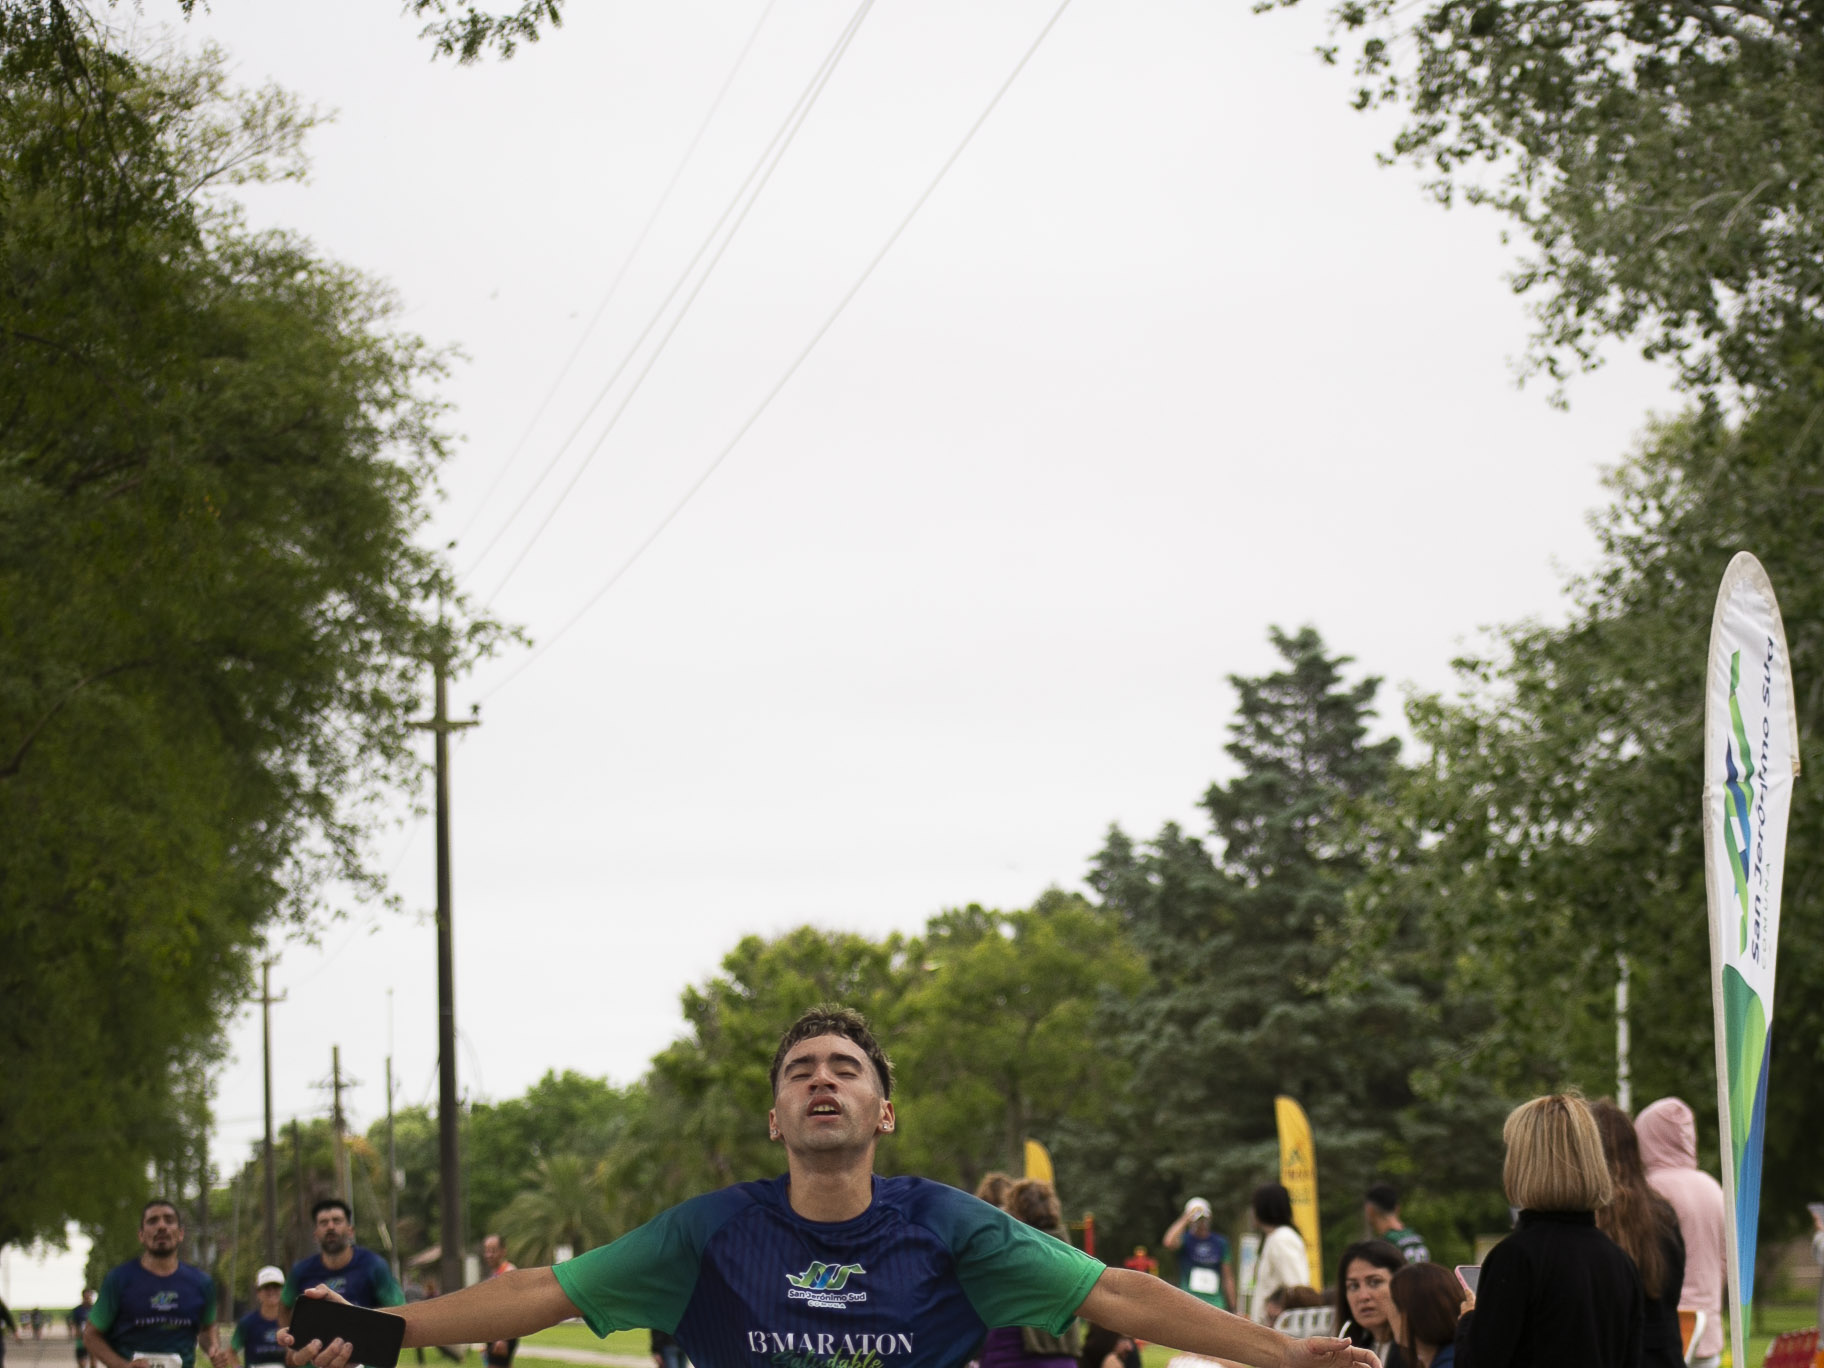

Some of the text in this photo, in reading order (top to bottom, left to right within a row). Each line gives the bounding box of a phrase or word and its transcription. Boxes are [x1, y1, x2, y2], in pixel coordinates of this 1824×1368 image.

[1751, 893, 1762, 965] San
[788, 1289, 805, 1299] San
[848, 1291, 867, 1302] Sud
[772, 1332, 914, 1355] MARATON
